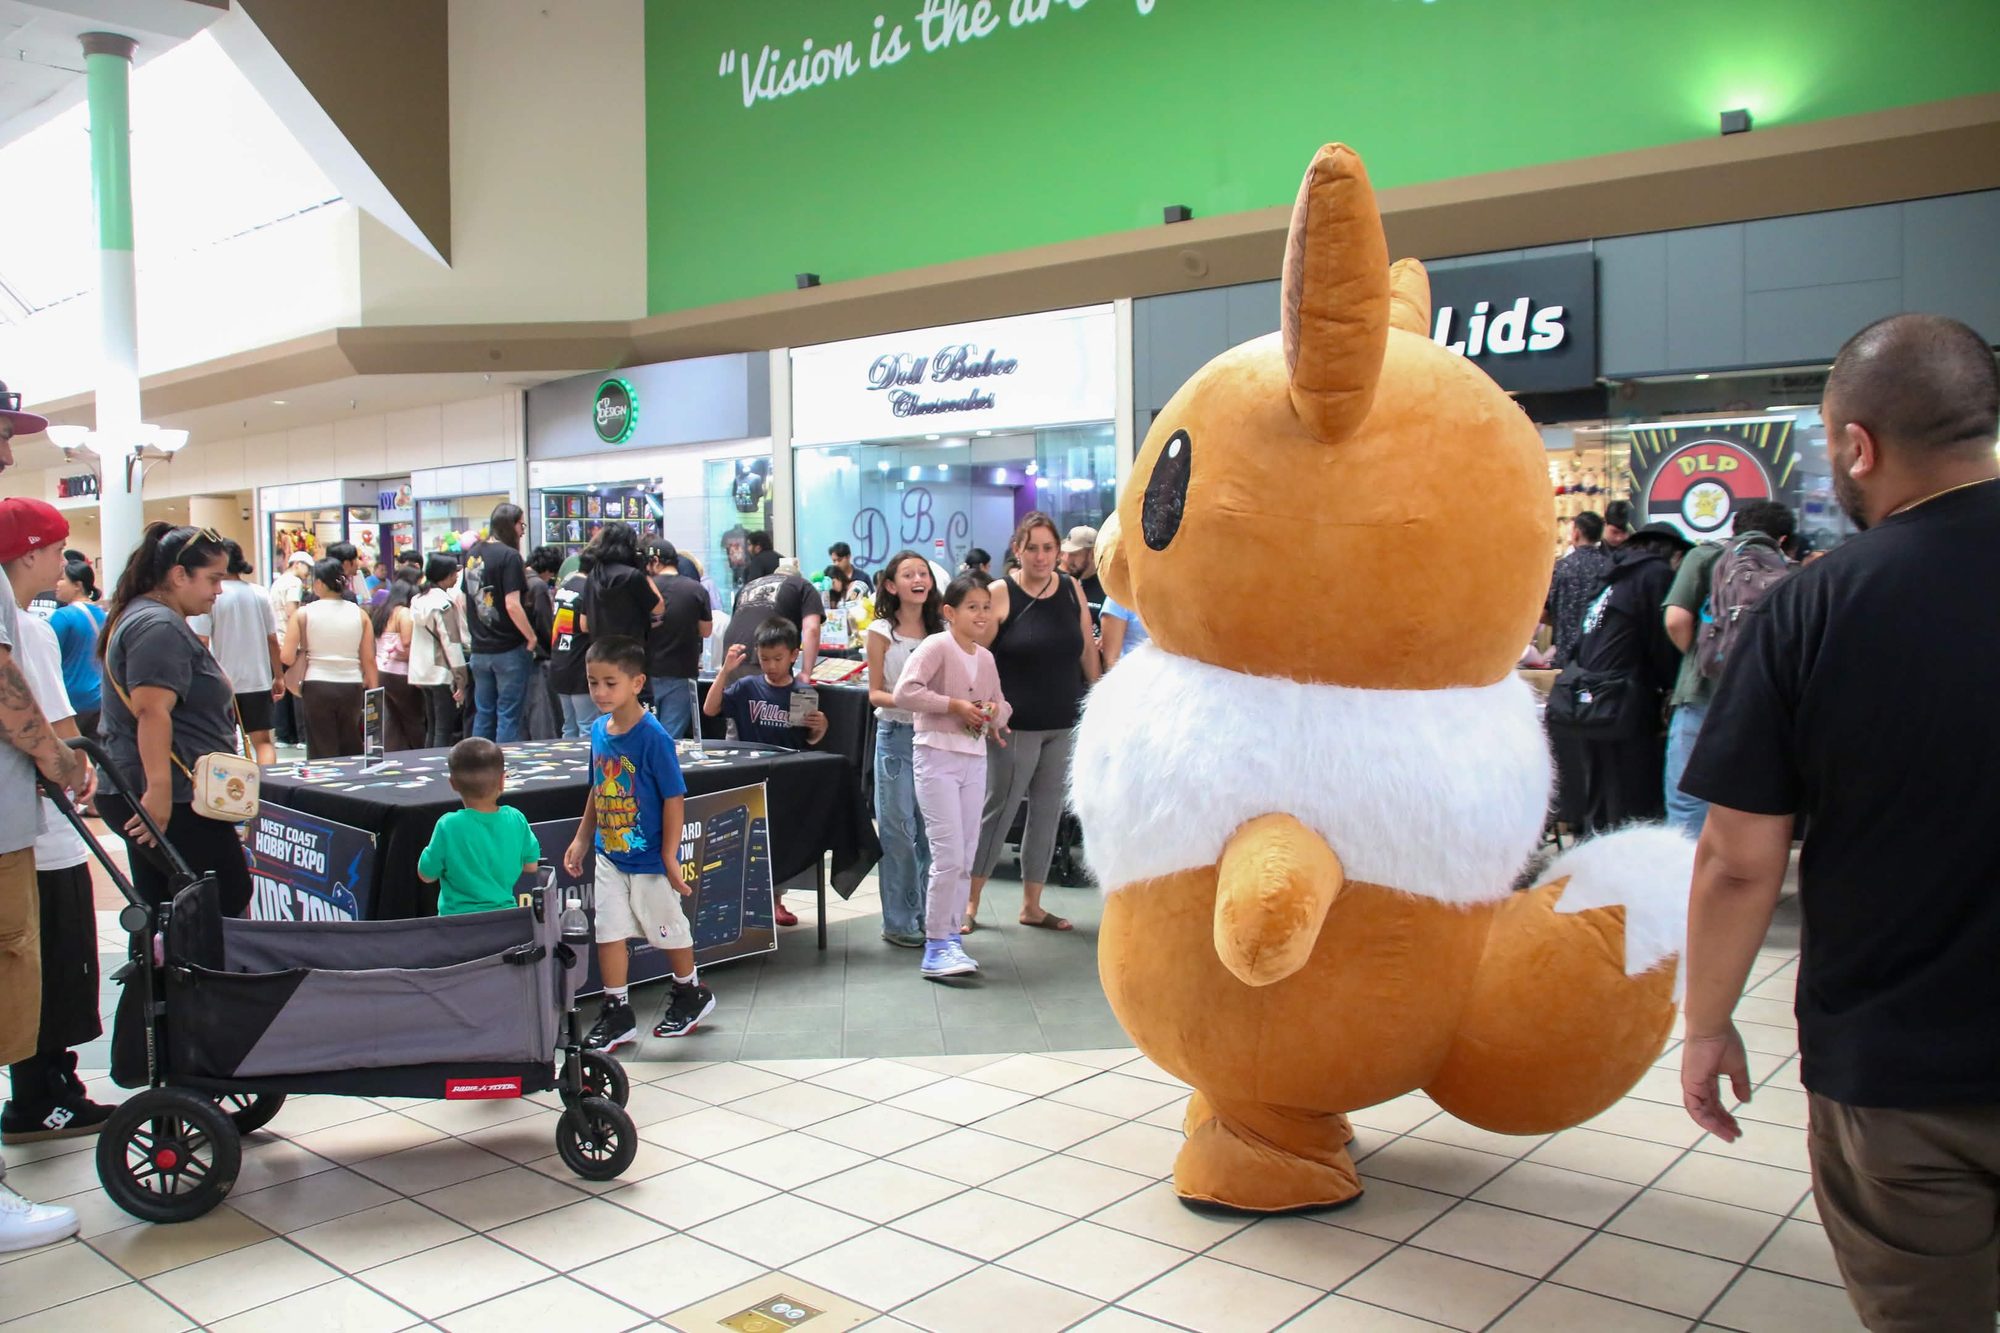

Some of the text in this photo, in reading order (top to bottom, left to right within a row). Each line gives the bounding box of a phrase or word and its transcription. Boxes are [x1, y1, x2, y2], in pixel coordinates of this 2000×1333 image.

[869, 15, 910, 68] is
[915, 0, 1001, 51] the
[1008, 0, 1091, 27] ar
[1433, 297, 1566, 357] Lids
[866, 353, 929, 391] Doll
[1677, 453, 1739, 476] DLP
[260, 818, 318, 849] WEST COAST
[680, 821, 702, 842] ARD
[256, 831, 325, 874] HOBBY EXPO
[250, 873, 353, 921] KIDS ZO
